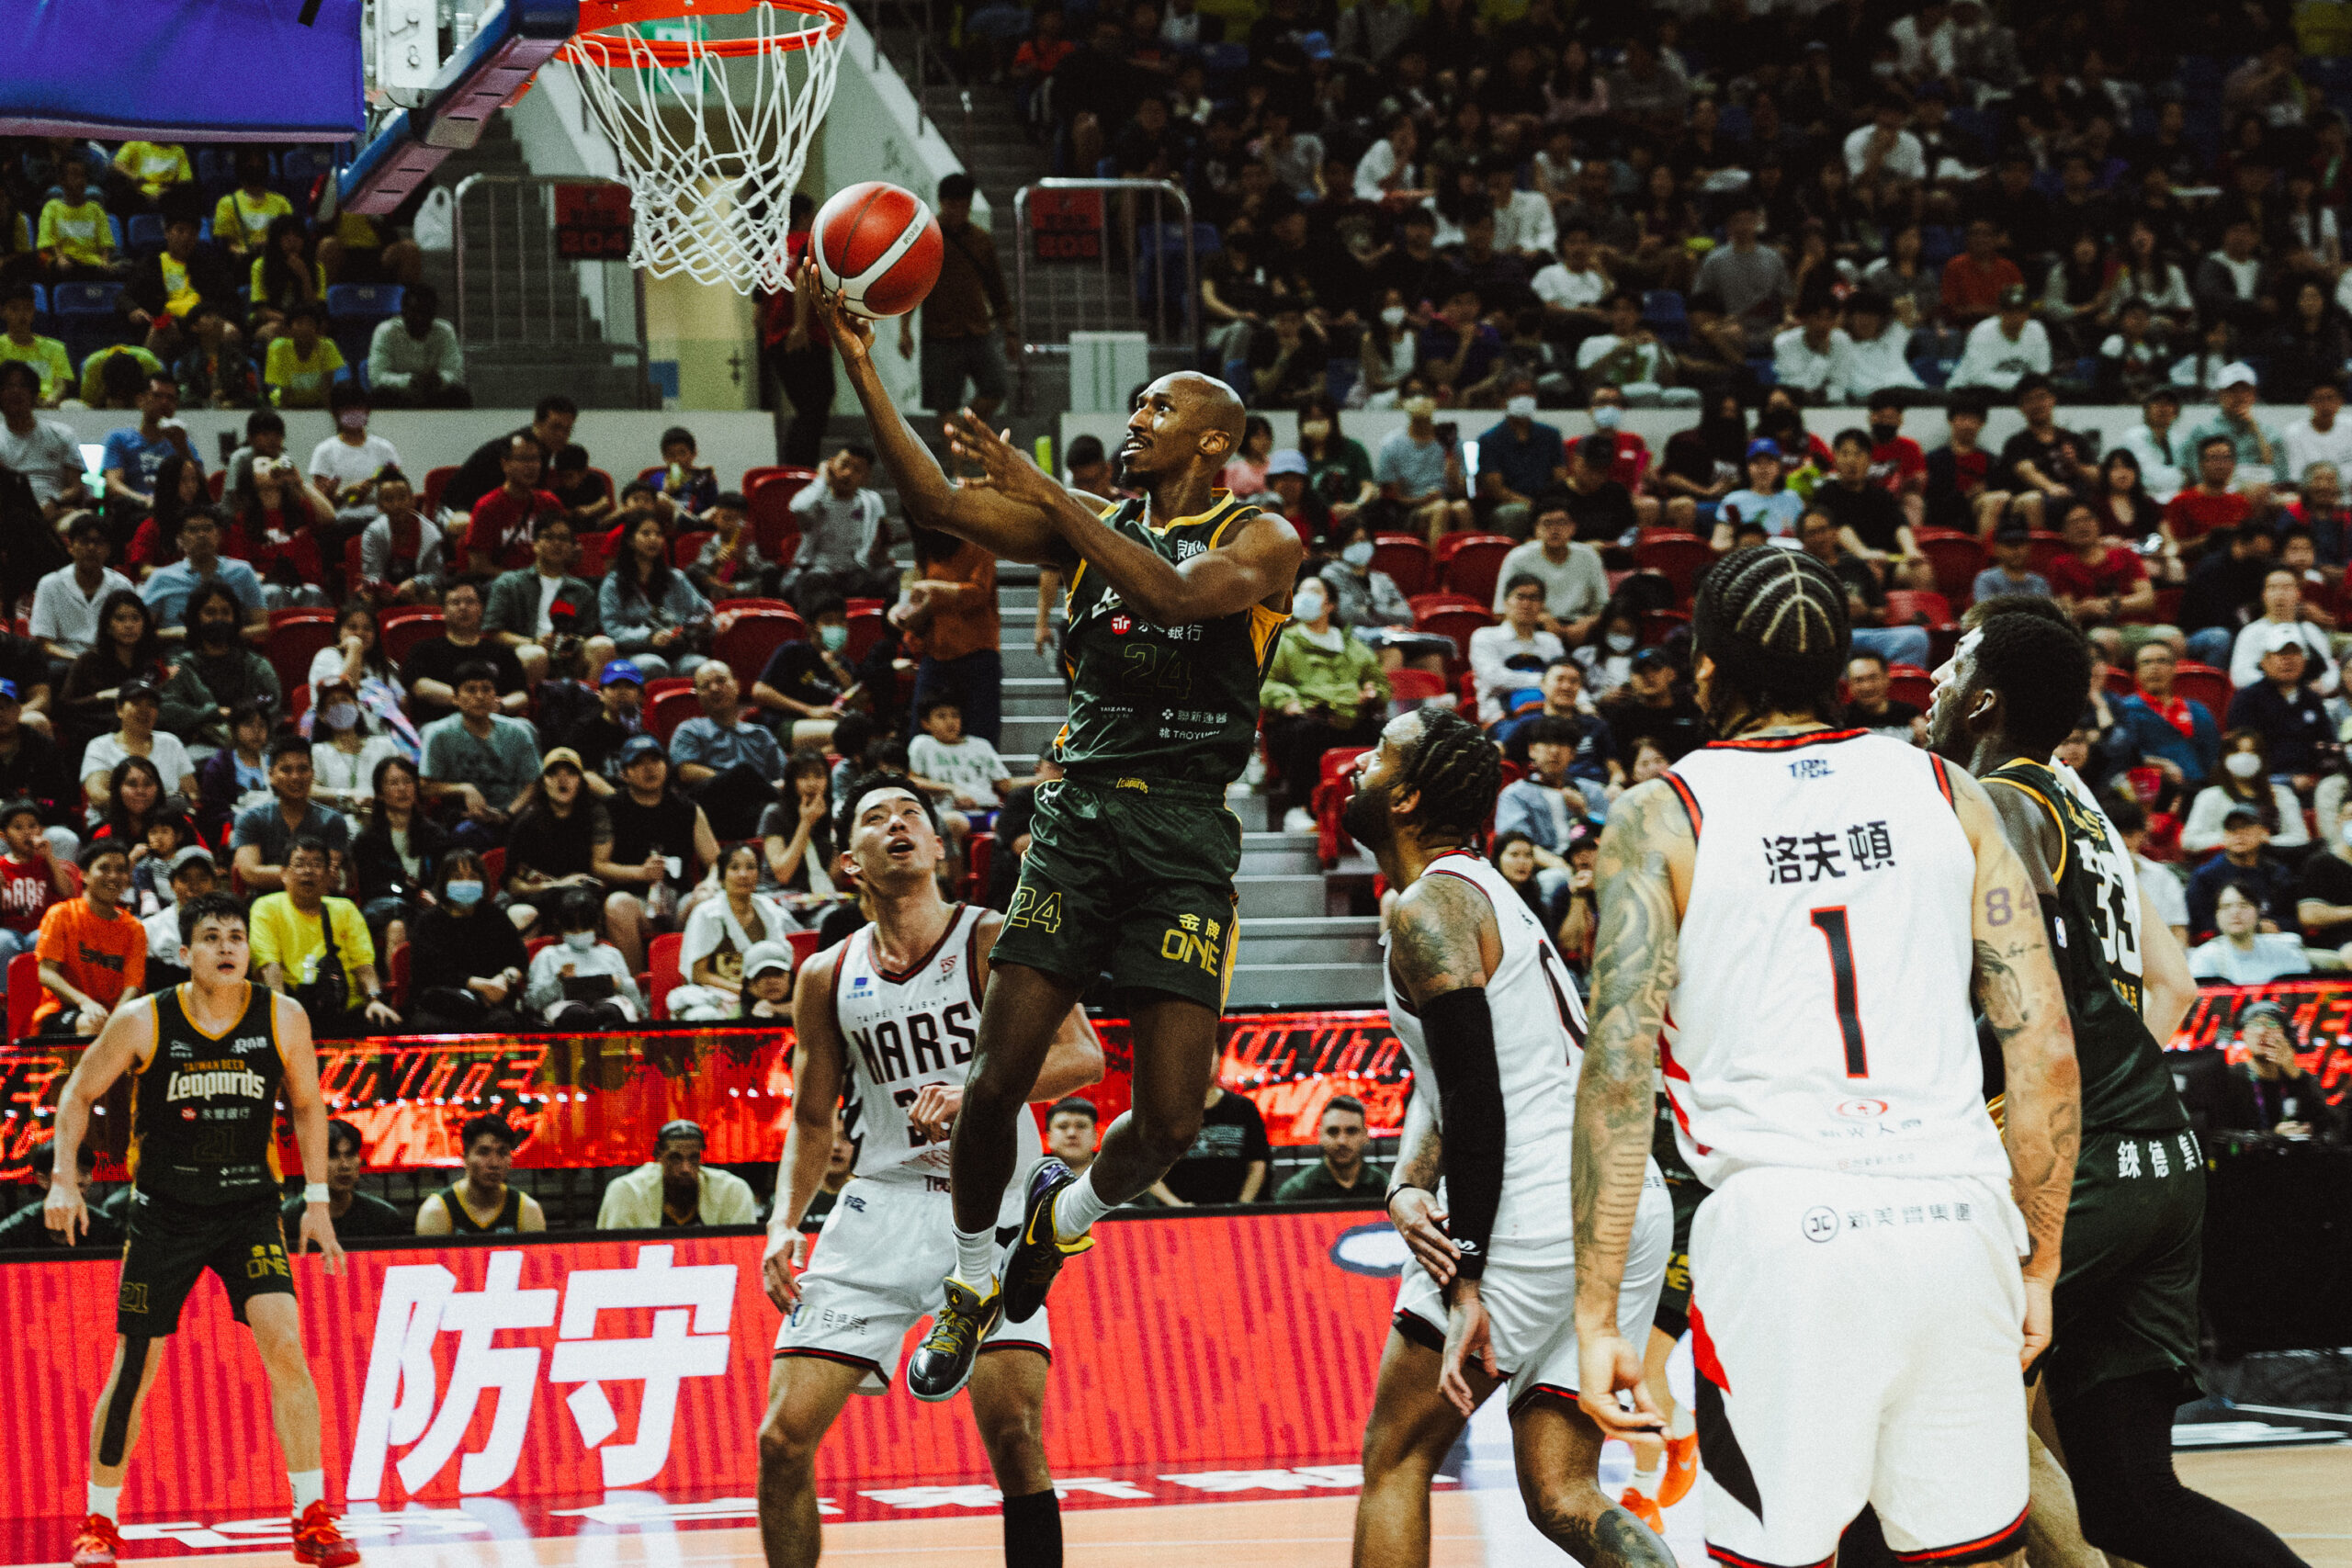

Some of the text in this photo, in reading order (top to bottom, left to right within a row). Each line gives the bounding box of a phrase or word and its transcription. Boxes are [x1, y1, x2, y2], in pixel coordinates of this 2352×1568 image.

[560, 231, 627, 253] 204
[1138, 619, 1204, 641] 永銀行
[1117, 643, 1192, 700] 24
[1762, 820, 1895, 885] 洛夫頓
[1009, 886, 1062, 933] 24
[1179, 913, 1221, 942] 金牌
[1161, 929, 1221, 977] ONE
[1810, 905, 1869, 1078] 1
[184, 1059, 245, 1073] TAIWAN BEER
[851, 1000, 978, 1086] MARS
[166, 1067, 266, 1102] Leopards
[2117, 1129, 2203, 1179] 錸德集
[245, 1257, 290, 1279] ONE
[345, 1244, 738, 1500] 防守
